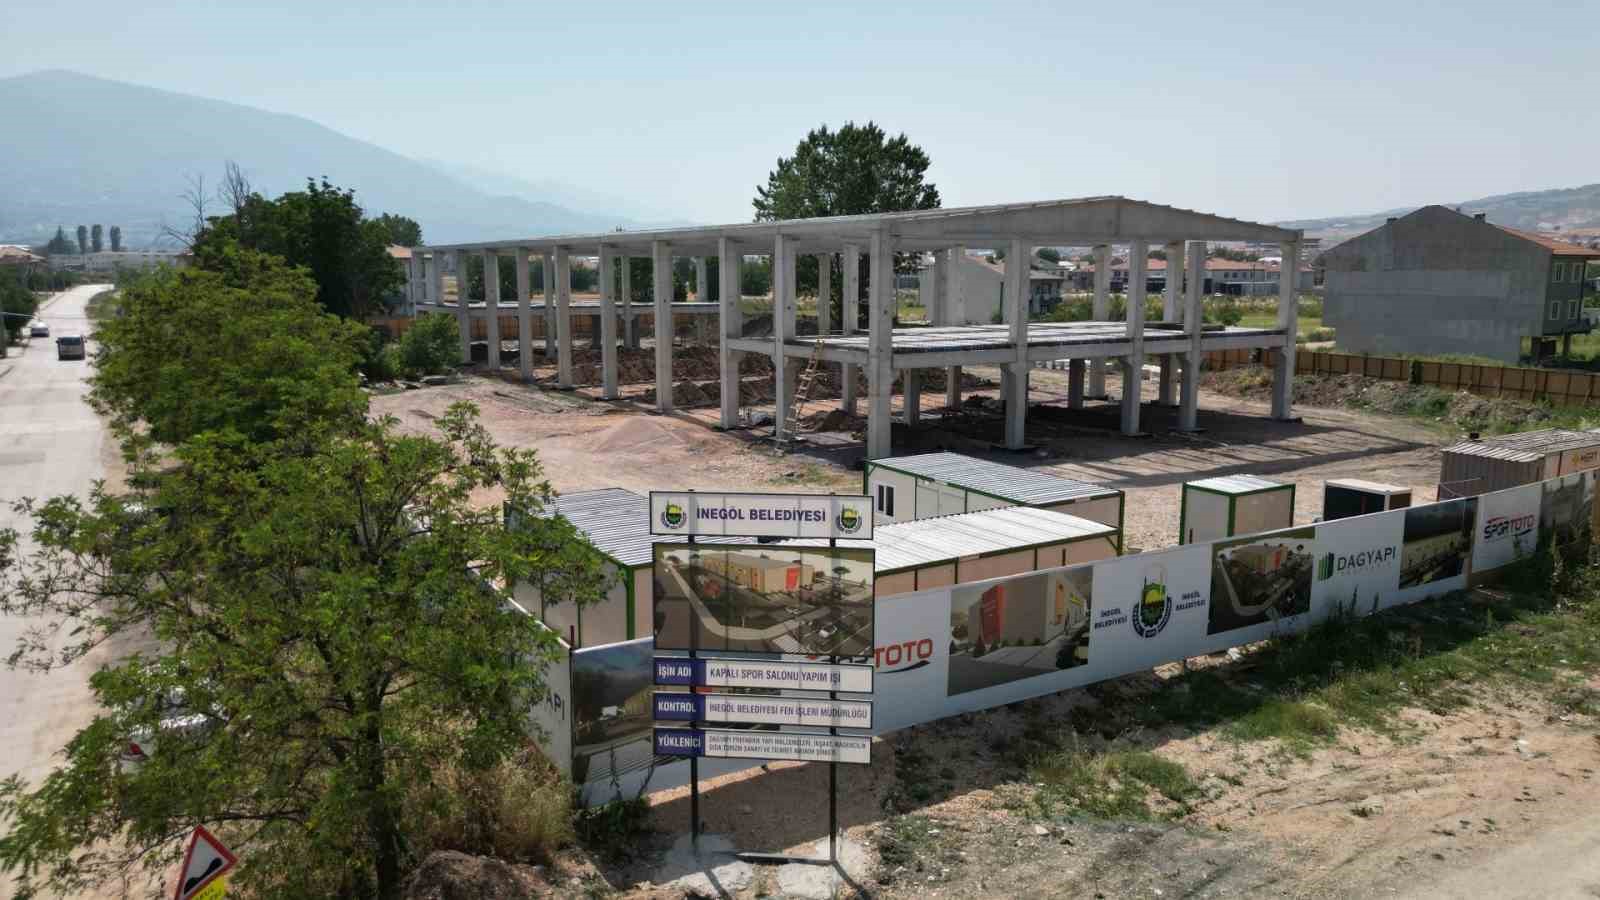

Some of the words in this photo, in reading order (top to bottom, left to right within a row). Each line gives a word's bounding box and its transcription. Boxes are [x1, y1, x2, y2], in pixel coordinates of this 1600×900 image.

[696, 504, 745, 520] İNEGÖL
[749, 507, 826, 522] BELEDİYESİ
[1337, 546, 1396, 571] DAGYAPI
[658, 664, 674, 679] İŞİN
[676, 666, 692, 677] ADI
[710, 667, 738, 679] KAPALI
[741, 669, 763, 680] SPOR
[766, 670, 799, 681] SALONU
[801, 671, 828, 683] YAPIM
[658, 701, 697, 713] KONTROL
[658, 733, 702, 749] YÜKLENİCİ
